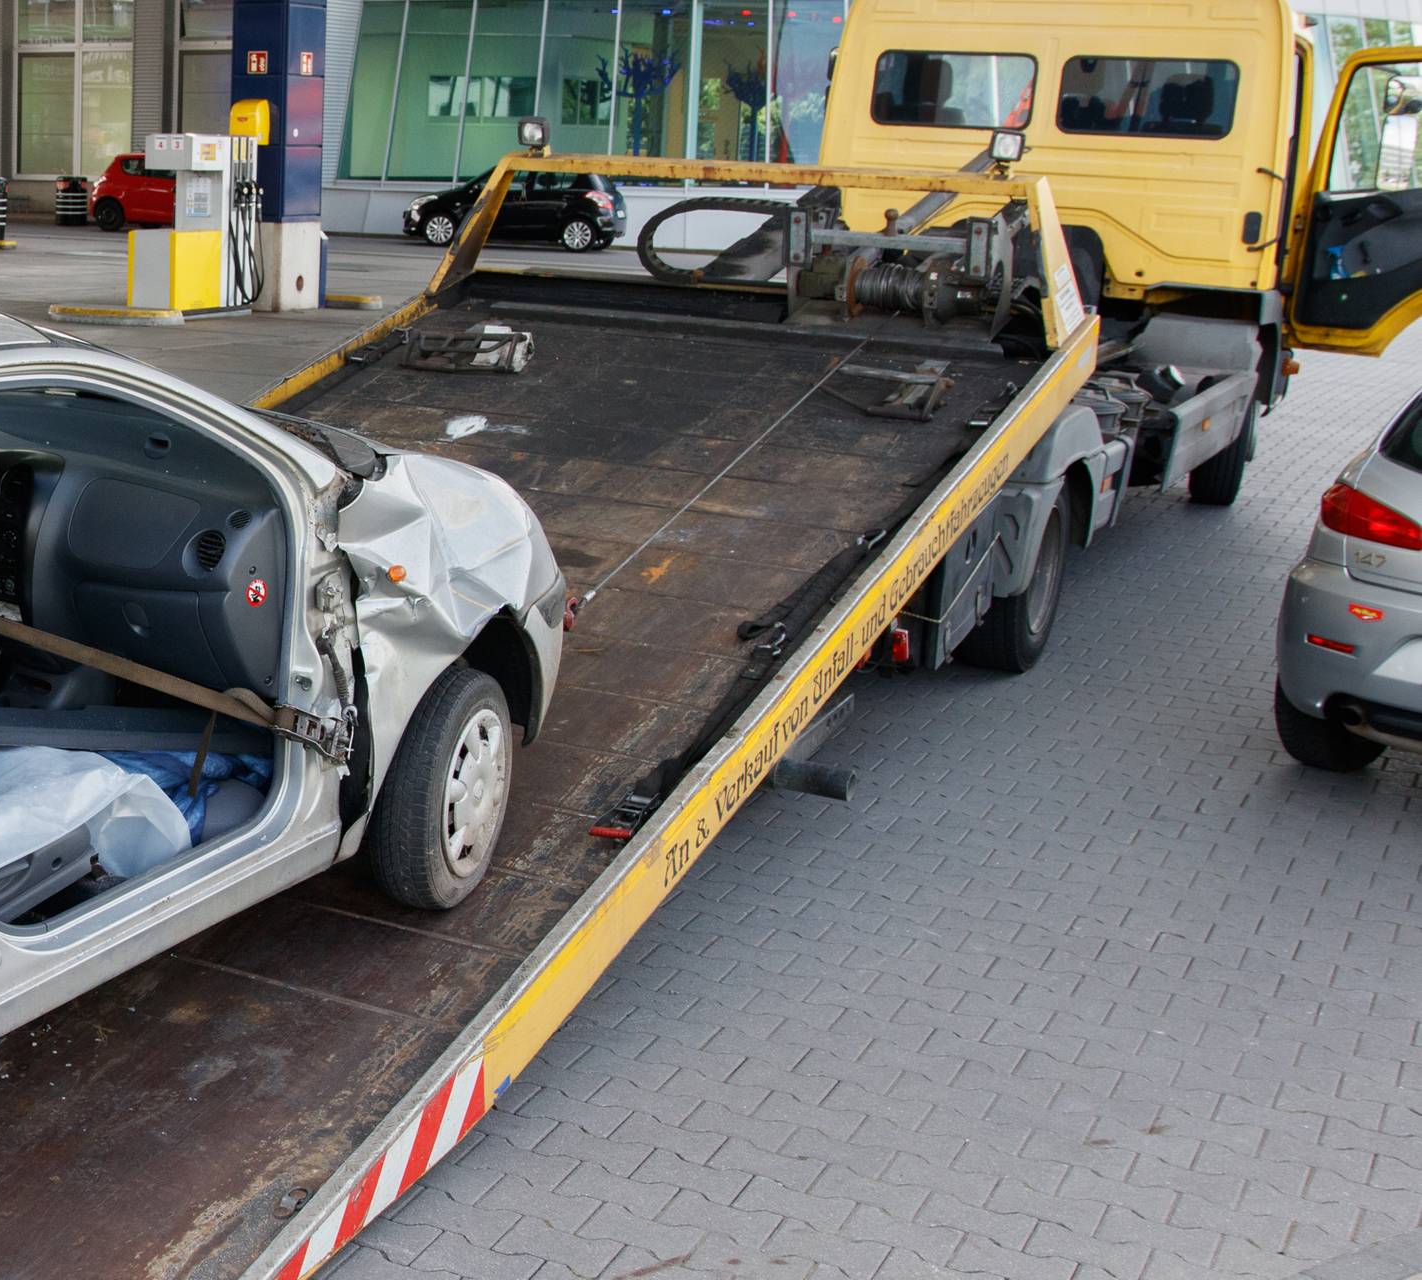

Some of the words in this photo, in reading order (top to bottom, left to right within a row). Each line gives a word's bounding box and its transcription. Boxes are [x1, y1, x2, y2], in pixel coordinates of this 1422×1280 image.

[665, 838, 690, 888] An
[696, 817, 710, 849] &
[714, 721, 780, 822] Verkauf
[782, 695, 809, 742] von
[889, 452, 1009, 611] Gebrauchtfahrzeugen
[1354, 550, 1387, 568] 147
